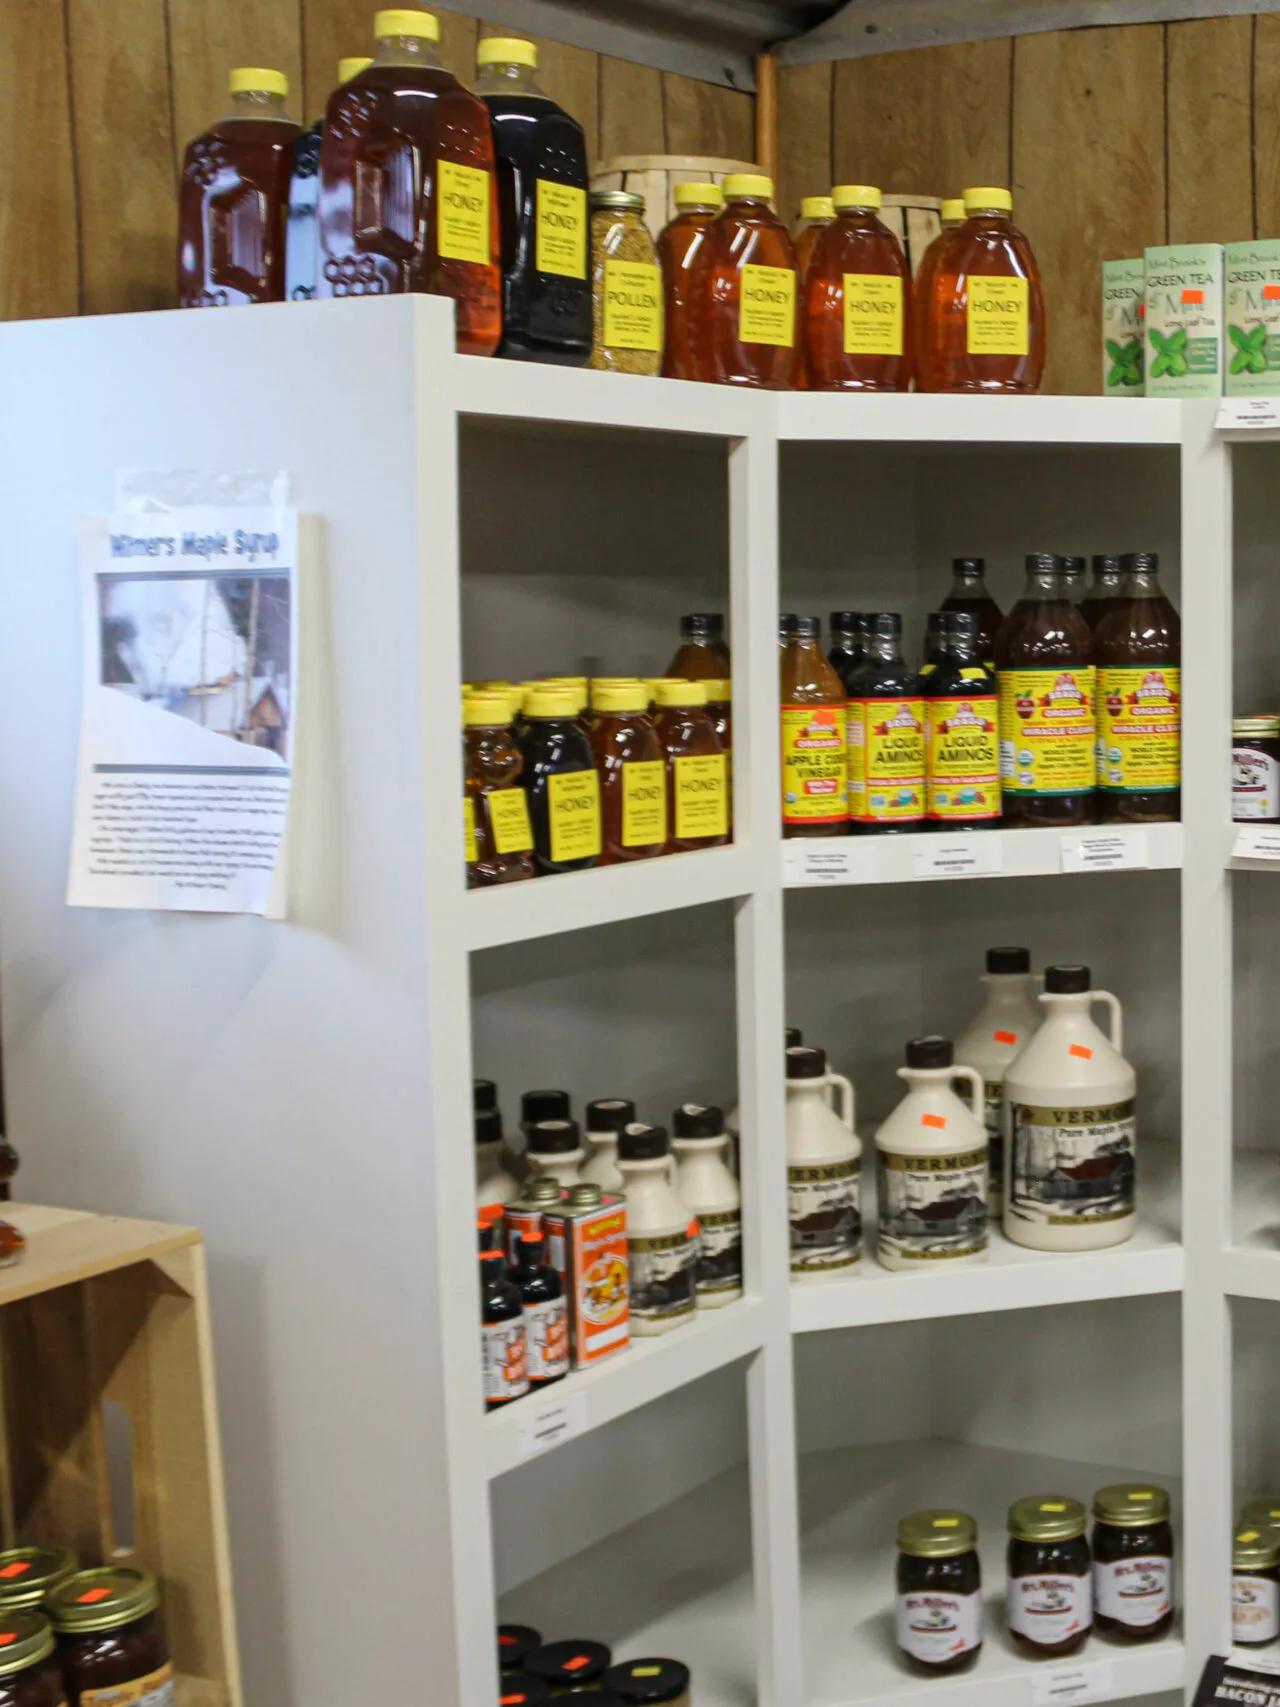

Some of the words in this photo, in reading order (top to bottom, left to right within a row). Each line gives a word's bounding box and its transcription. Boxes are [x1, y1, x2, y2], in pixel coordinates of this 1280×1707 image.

[444, 192, 483, 213] HONEY
[542, 211, 579, 230] HONEY
[1147, 273, 1185, 287] GREEN
[1190, 273, 1214, 284] TEA
[1227, 270, 1266, 283] GREEN
[608, 291, 656, 308] POLLEN
[745, 289, 791, 304] HONEY
[851, 301, 896, 314] HONEY
[972, 300, 1023, 313] HONEY
[945, 736, 988, 748] LIQUID
[786, 756, 821, 766] APPLE
[938, 749, 993, 762] AMINOS
[797, 767, 841, 777] VINEGAR
[681, 778, 721, 792] HONEY
[629, 787, 663, 801] HONEY
[555, 797, 594, 813] HONEY
[1214, 1686, 1267, 1705] BACON
